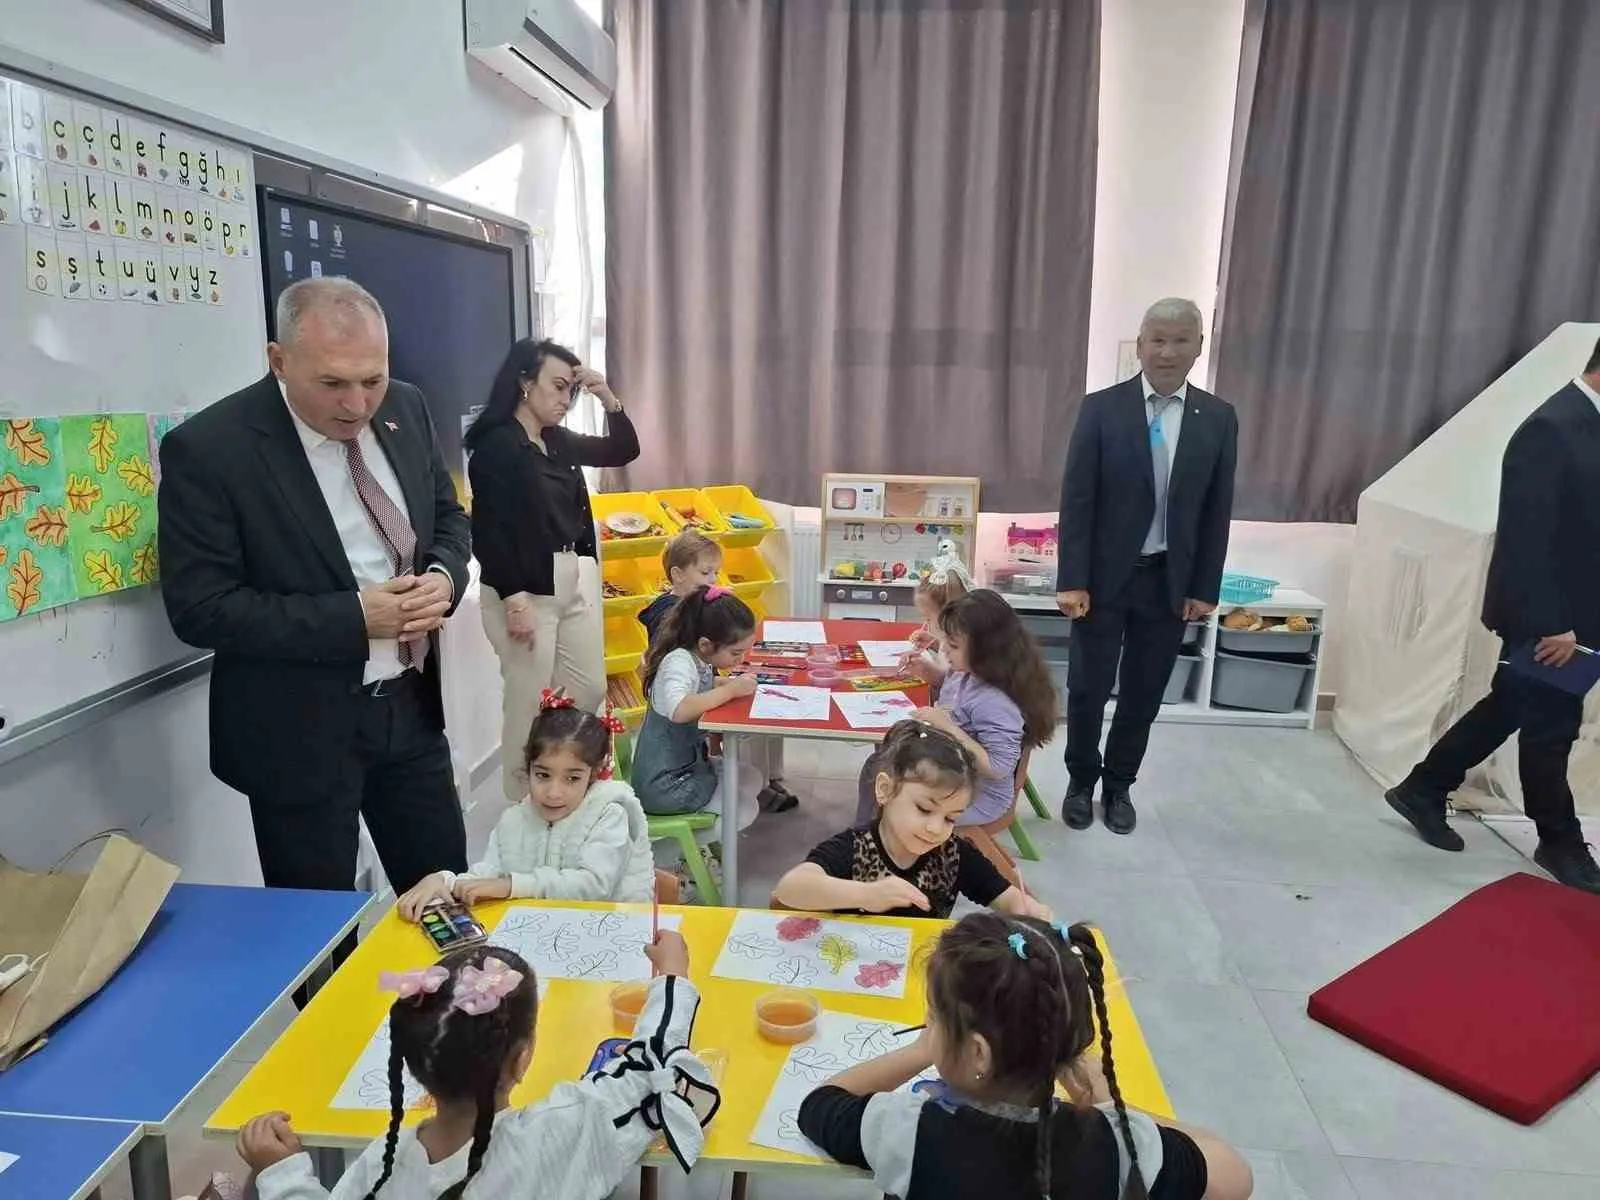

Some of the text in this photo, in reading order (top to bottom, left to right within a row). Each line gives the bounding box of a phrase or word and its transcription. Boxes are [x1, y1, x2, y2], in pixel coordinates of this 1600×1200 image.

[54, 120, 65, 138] c
[83, 126, 94, 150] ç
[111, 119, 121, 151] d
[136, 141, 146, 157] e
[157, 132, 166, 161] f
[179, 151, 188, 180] g
[198, 152, 208, 185] ğ
[216, 150, 225, 180] h
[62, 182, 70, 220] j
[86, 176, 96, 208] k
[114, 181, 122, 214] l
[137, 201, 152, 219] m
[163, 209, 173, 224] n
[184, 211, 194, 225] o
[204, 210, 213, 231] ö
[223, 222, 231, 248] p
[239, 224, 246, 237] r
[36, 250, 218, 292] s ş t u ü v y z
